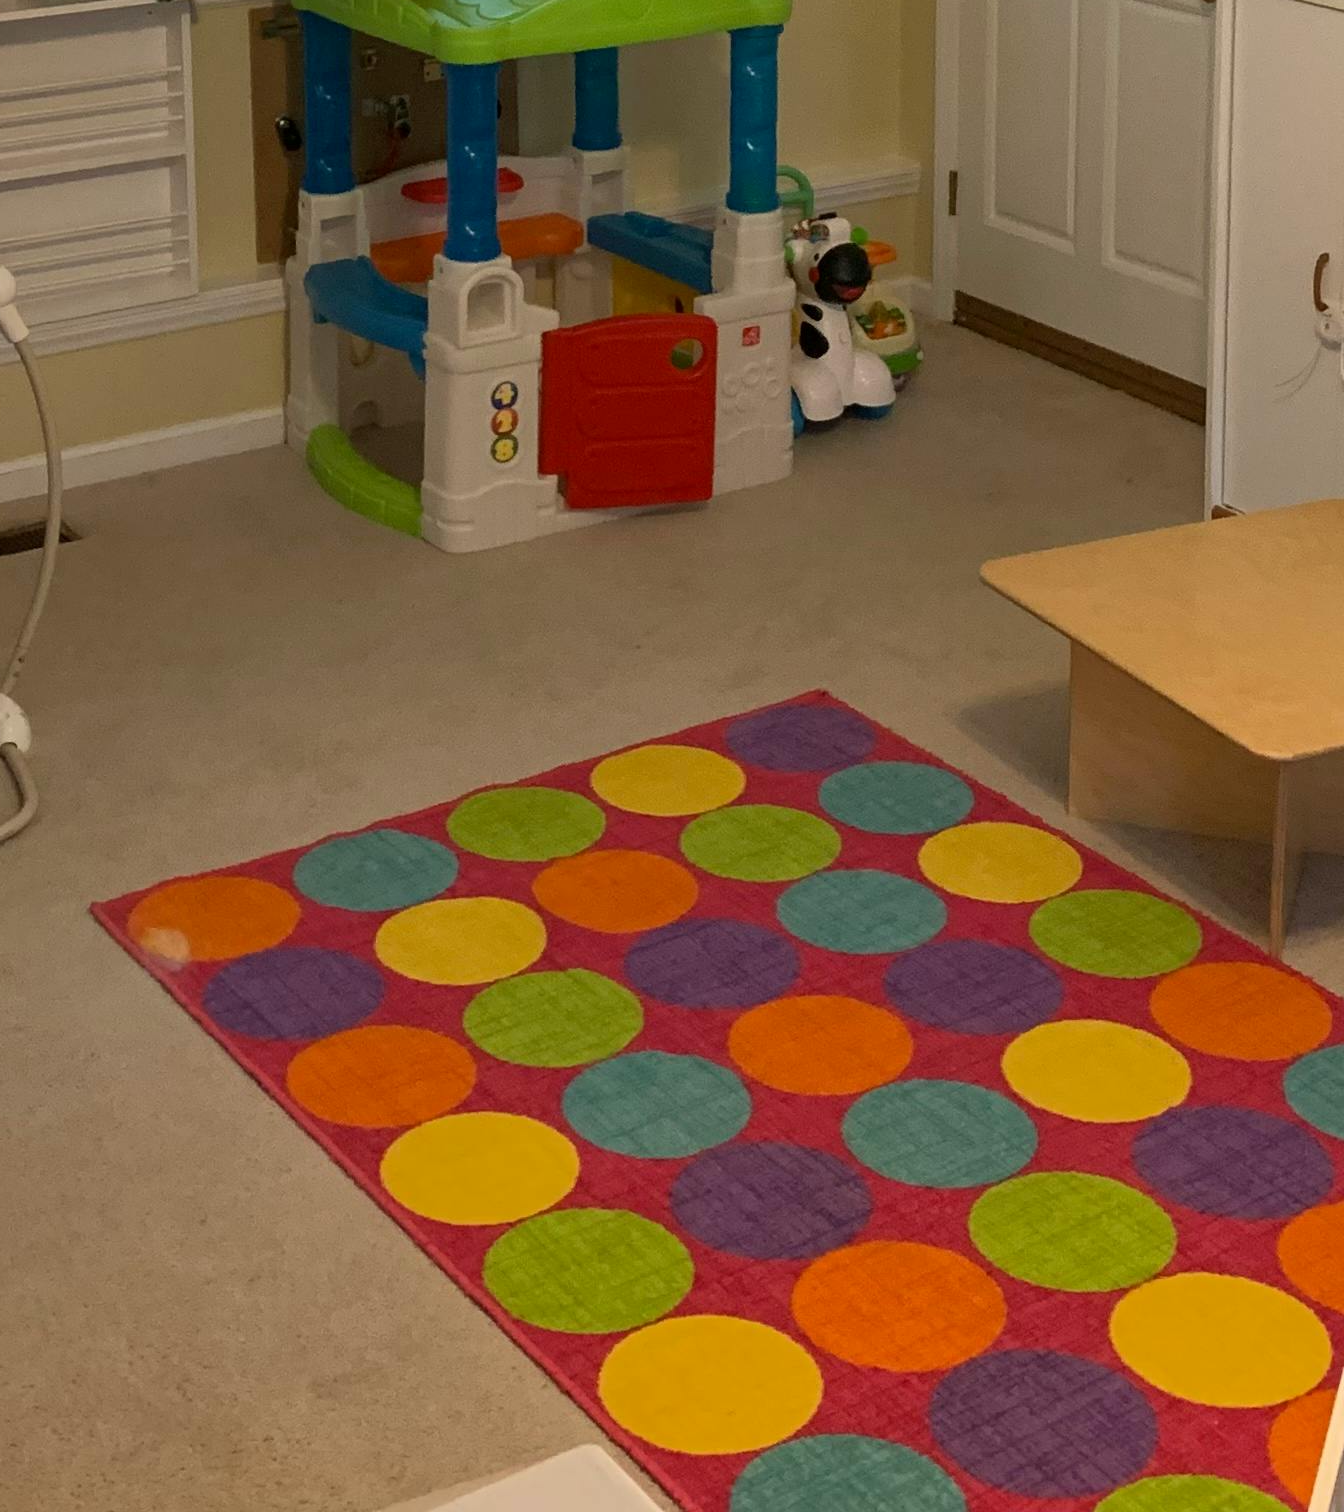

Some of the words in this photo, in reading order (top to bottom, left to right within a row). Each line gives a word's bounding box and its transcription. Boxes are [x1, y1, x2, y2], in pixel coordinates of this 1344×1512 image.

[494, 383, 514, 405] 4
[496, 409, 513, 433] 2
[494, 438, 515, 461] 8
